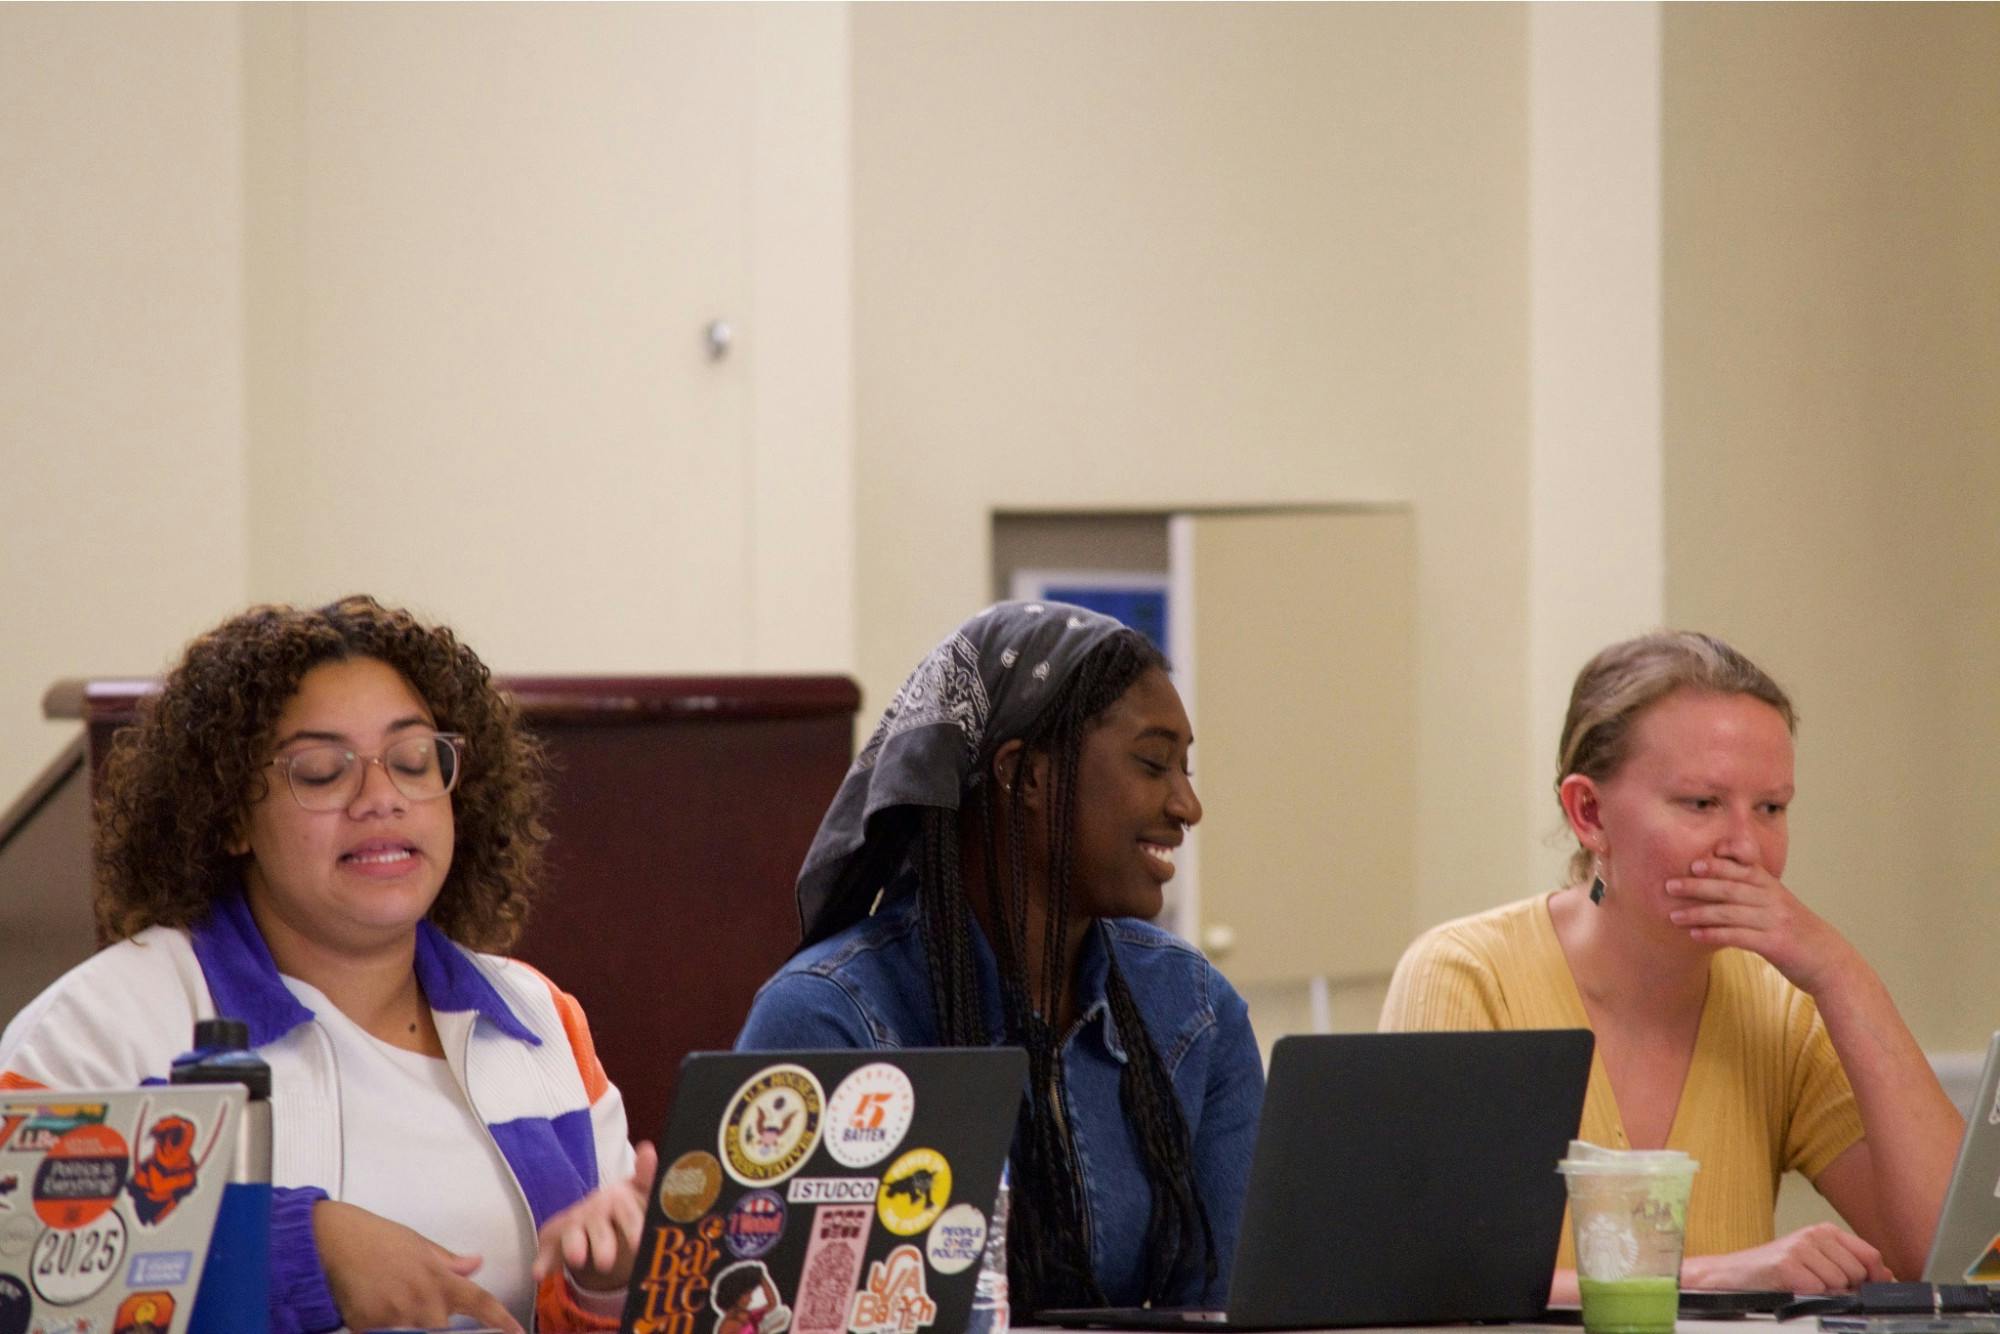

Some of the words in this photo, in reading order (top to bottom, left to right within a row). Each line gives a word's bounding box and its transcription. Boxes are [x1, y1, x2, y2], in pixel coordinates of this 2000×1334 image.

[843, 1128, 886, 1141] BATTEN
[801, 1182, 875, 1198] STUDCO
[942, 1226, 982, 1238] PEOPLE
[931, 1247, 981, 1260] POLITICS
